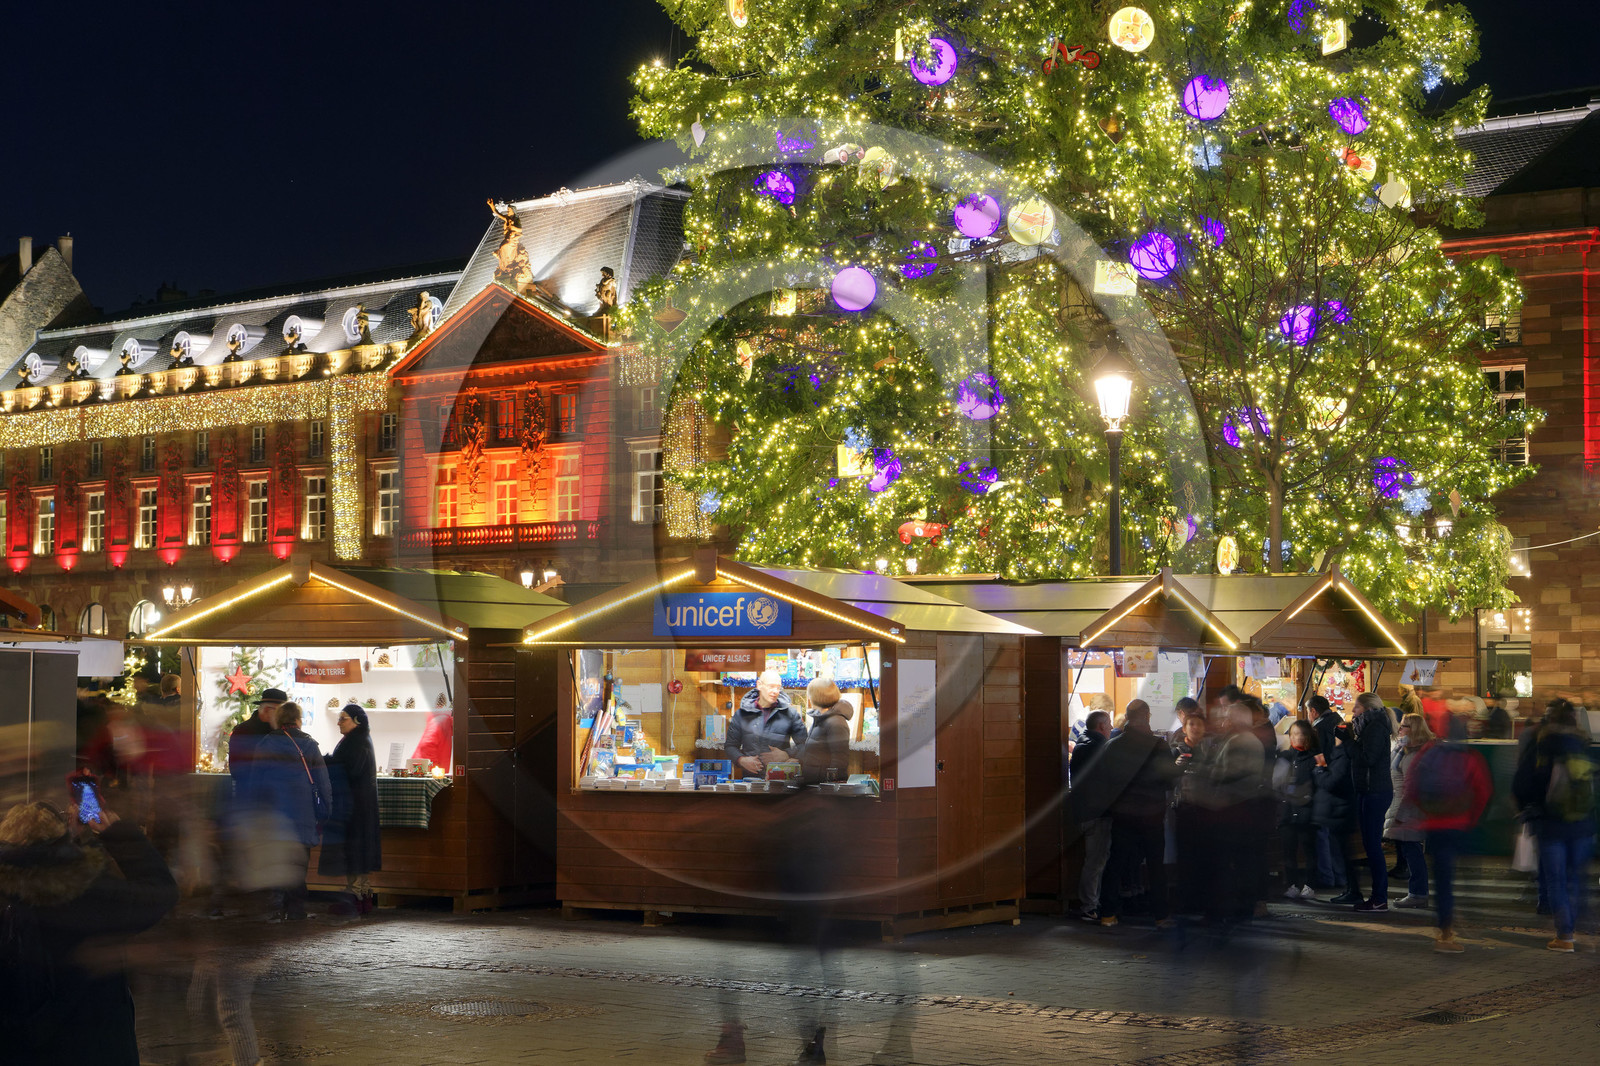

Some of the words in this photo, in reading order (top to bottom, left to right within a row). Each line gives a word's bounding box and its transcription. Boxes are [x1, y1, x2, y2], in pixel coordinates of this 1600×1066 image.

[666, 597, 745, 627] unicef
[702, 654, 726, 663] UNICEF
[726, 654, 751, 663] ALSACE
[304, 667, 318, 675] CLAIR
[318, 668, 326, 676] DE
[327, 667, 346, 676] TERRE
